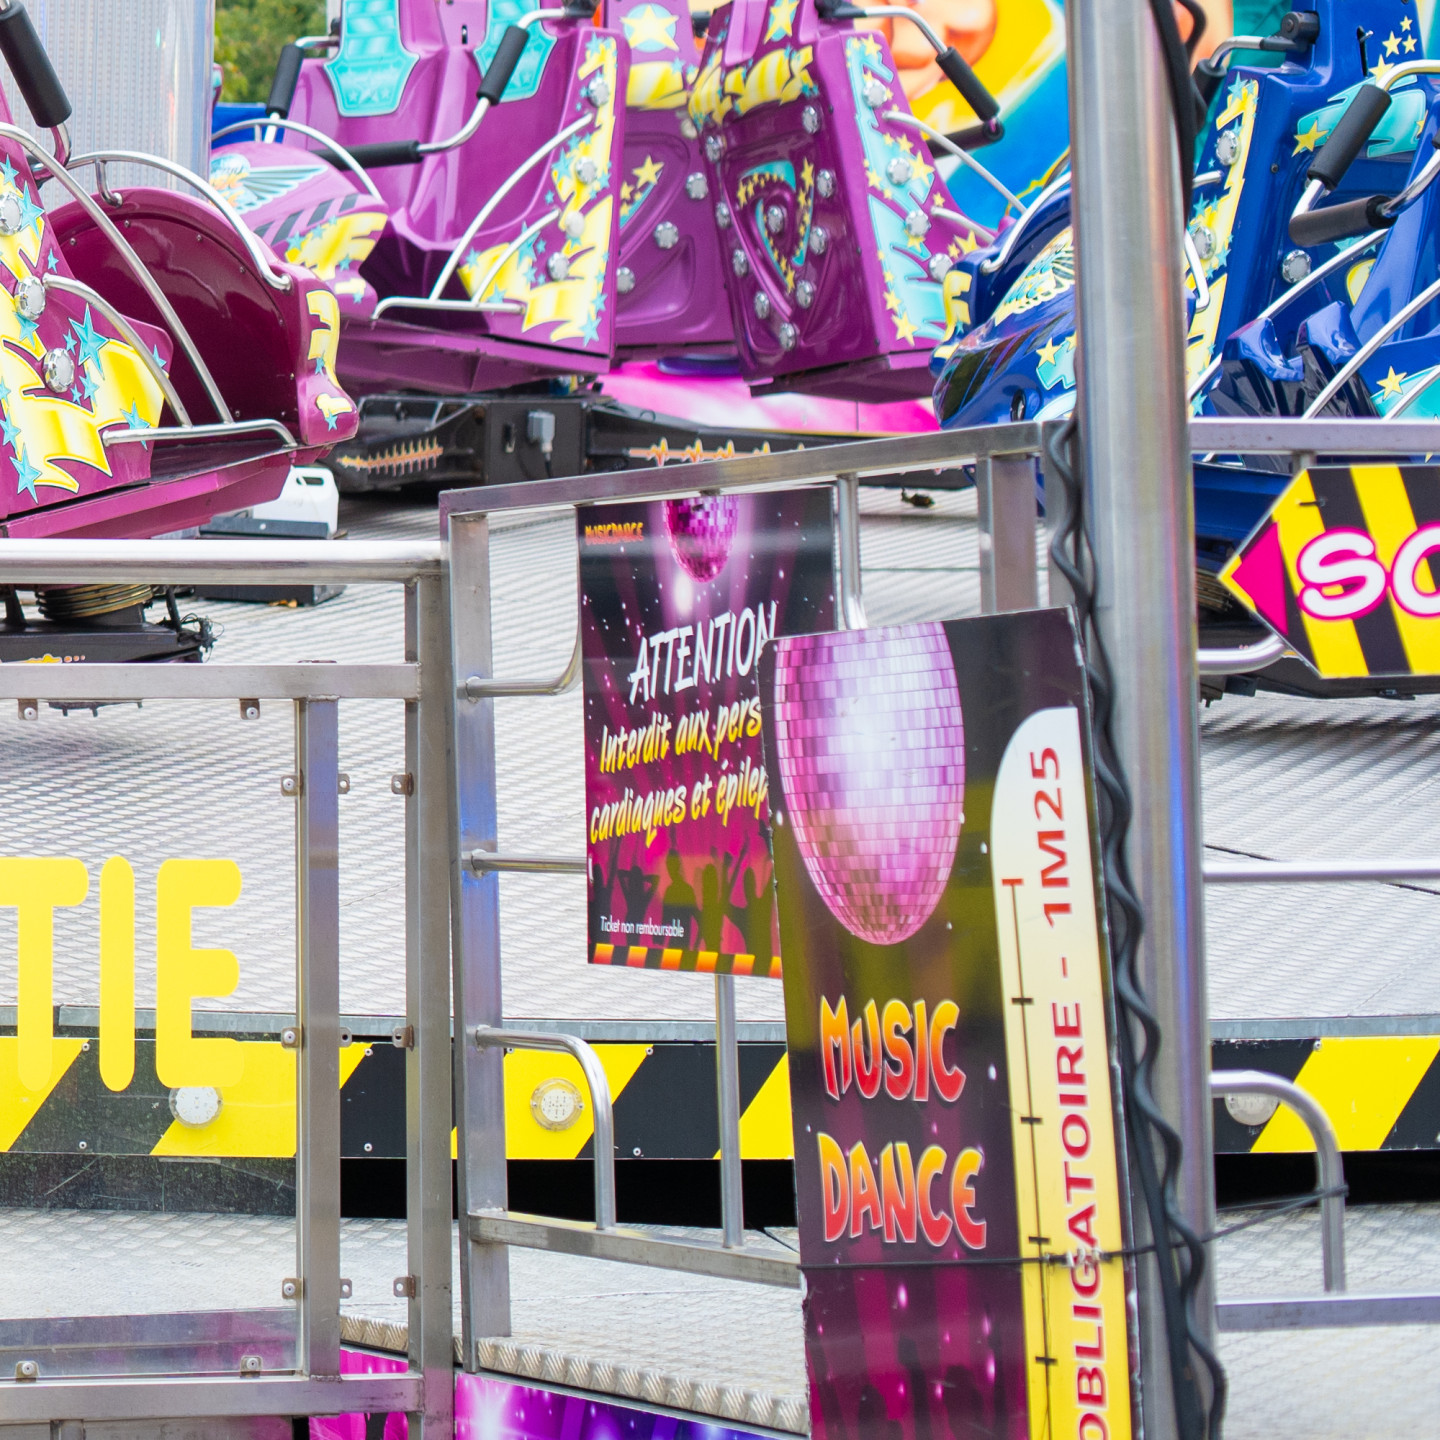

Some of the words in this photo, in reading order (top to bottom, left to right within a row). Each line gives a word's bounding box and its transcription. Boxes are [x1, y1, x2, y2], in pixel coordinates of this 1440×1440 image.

[627, 600, 777, 705] ATTENTION
[600, 711, 672, 774] Interdit
[675, 709, 712, 755] aux
[590, 786, 687, 848] cardiaques
[691, 773, 711, 820] et
[1030, 747, 1073, 928] 1M25
[600, 915, 620, 932] Ticket
[621, 923, 635, 934] non
[636, 918, 684, 937] remboursable
[821, 995, 966, 1102] MUSIC
[817, 1132, 986, 1249] DANCE
[1052, 1002, 1107, 1440] OBLIGATOIRE
